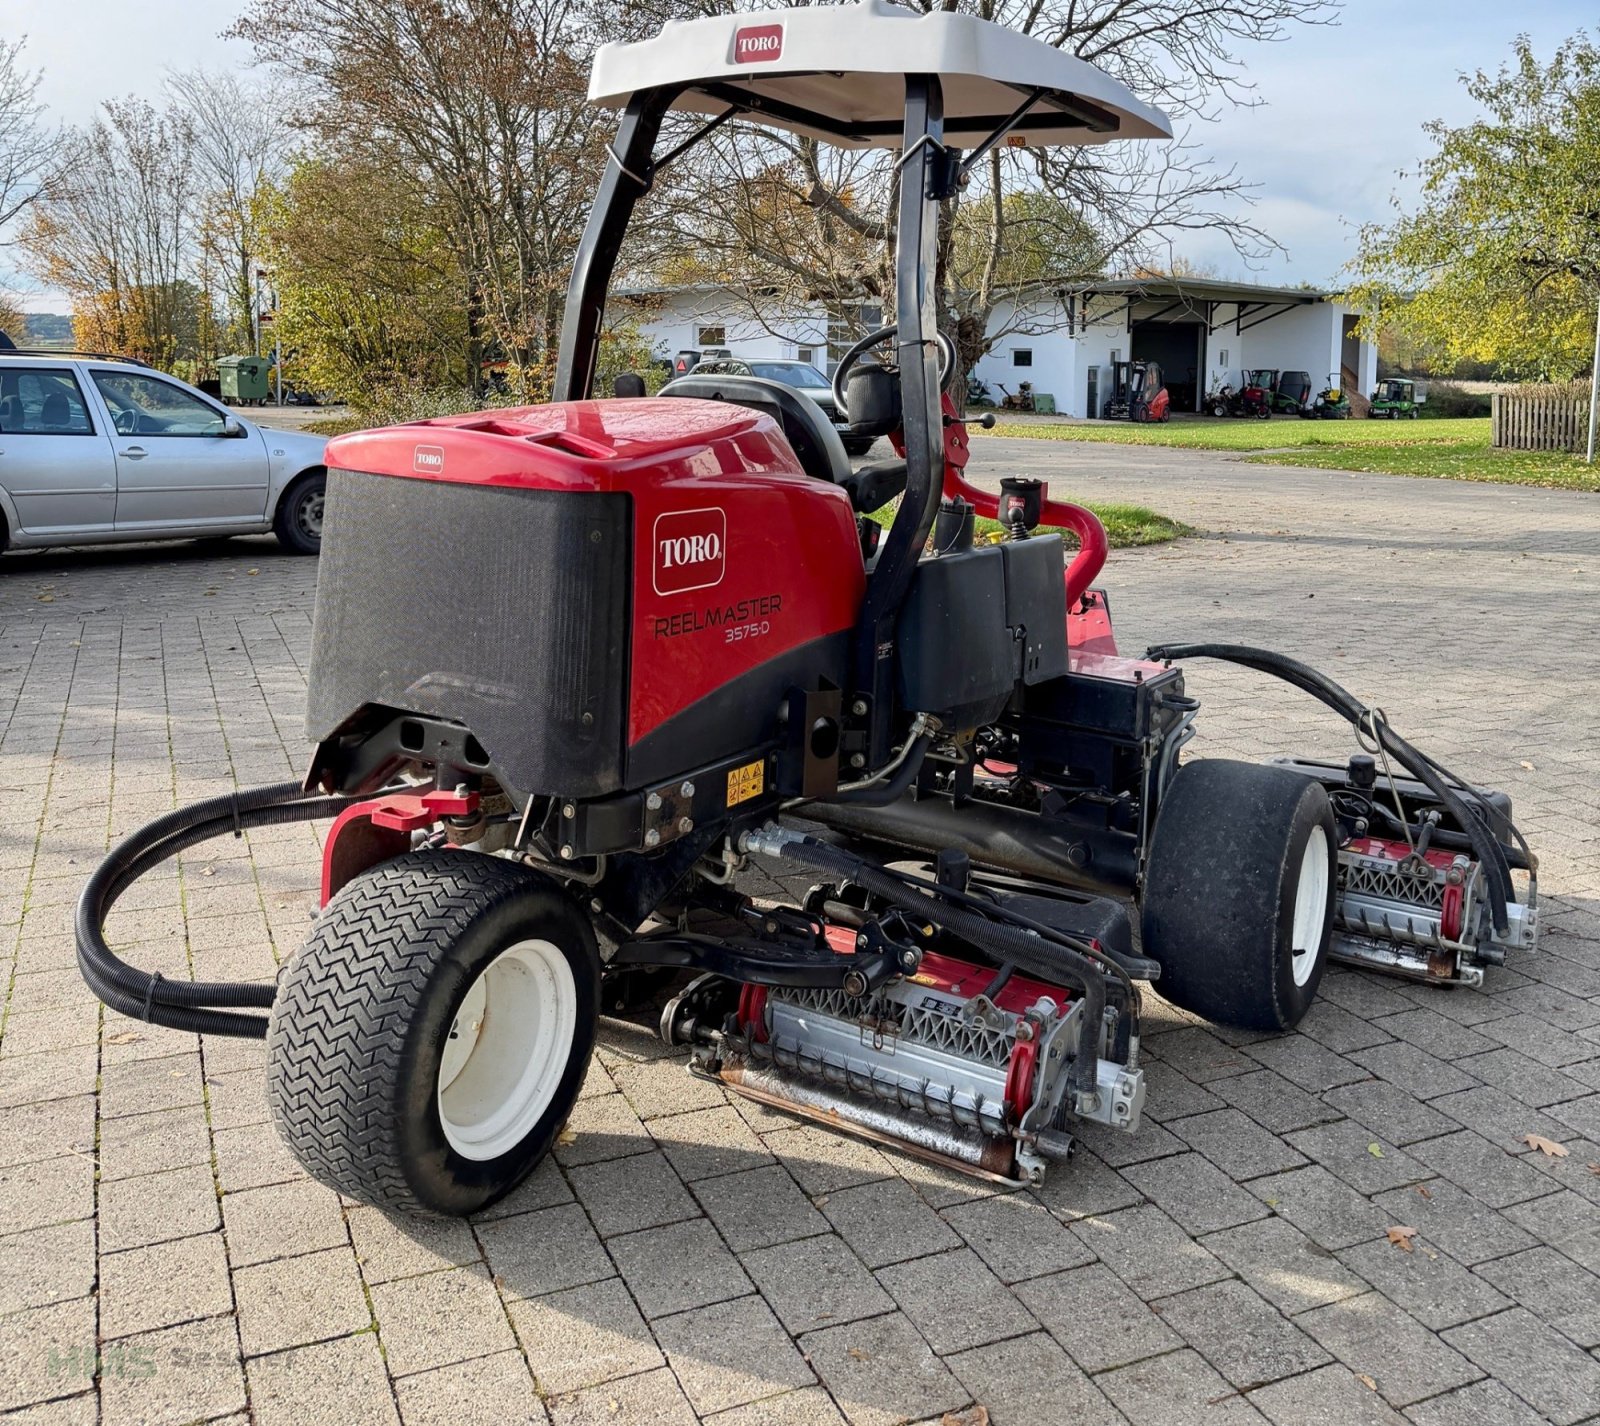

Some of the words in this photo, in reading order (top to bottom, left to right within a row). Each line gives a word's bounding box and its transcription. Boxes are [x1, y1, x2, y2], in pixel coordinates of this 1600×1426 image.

[739, 35, 779, 53] TORO
[416, 453, 442, 466] TORO
[659, 533, 720, 569] TORO
[654, 594, 782, 640] REELMASTER
